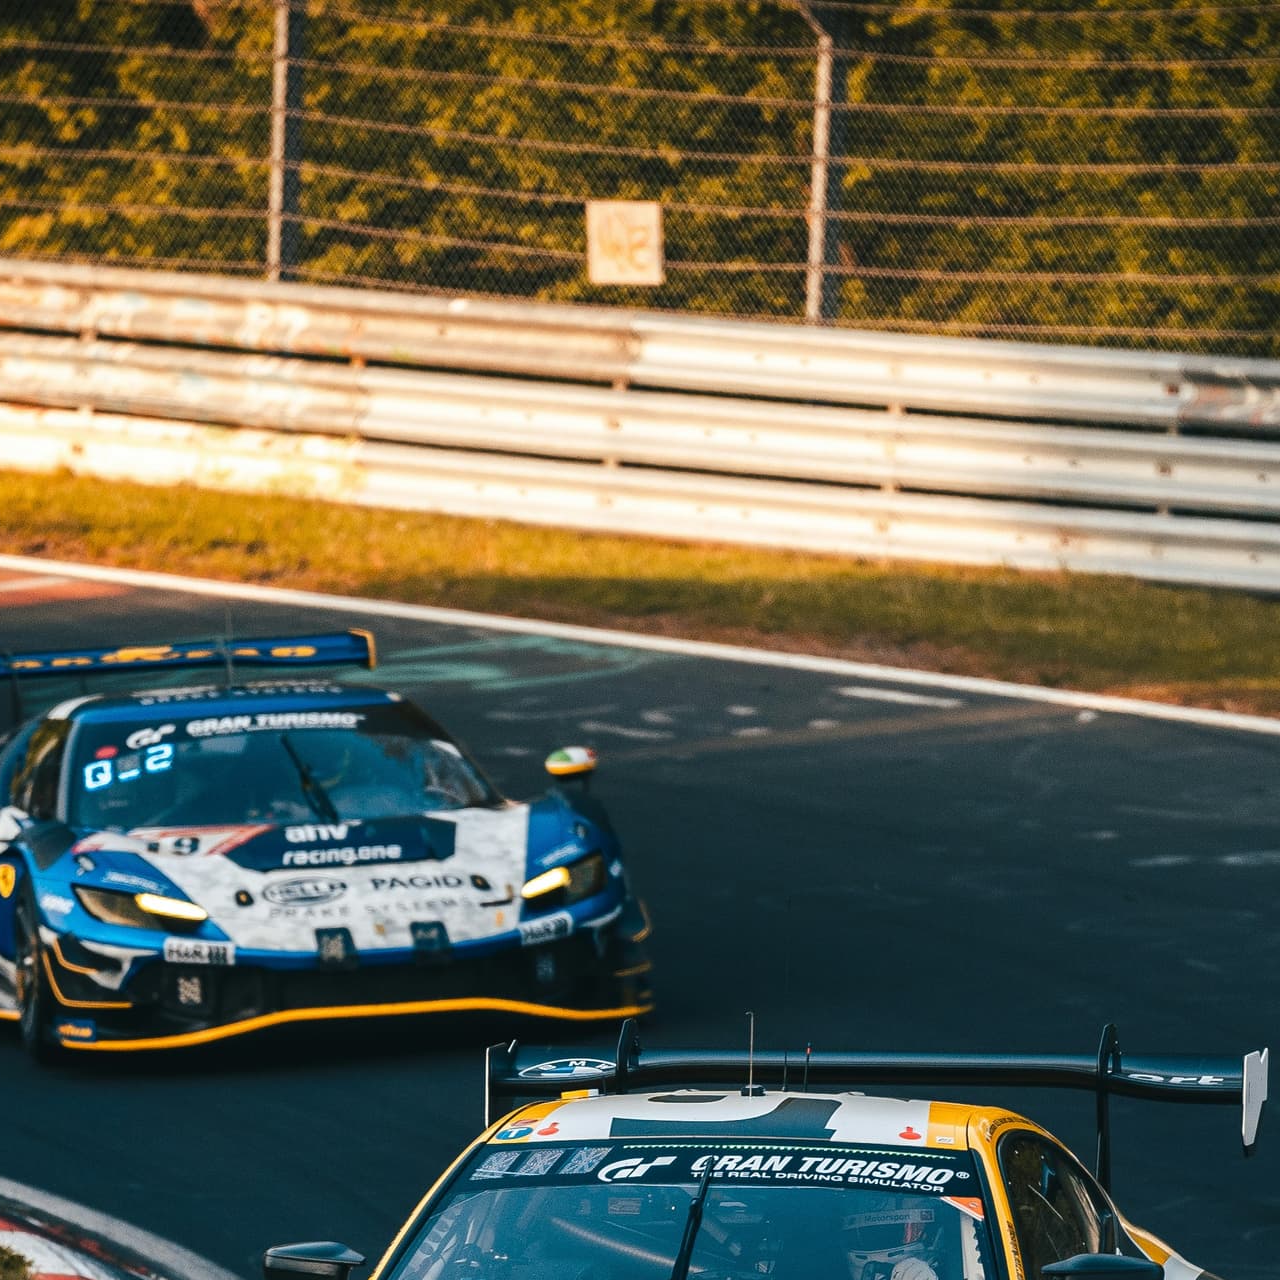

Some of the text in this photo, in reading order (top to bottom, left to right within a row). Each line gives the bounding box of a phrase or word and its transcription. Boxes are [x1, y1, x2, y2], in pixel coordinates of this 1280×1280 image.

[186, 715, 251, 735] GRAN
[371, 875, 462, 891] PAGID
[270, 904, 351, 918] BRAKE
[691, 1154, 790, 1173] GRAN
[728, 1171, 772, 1180] REAL
[775, 1171, 844, 1182] DRIVING
[847, 1176, 945, 1193] SIMULATOR
